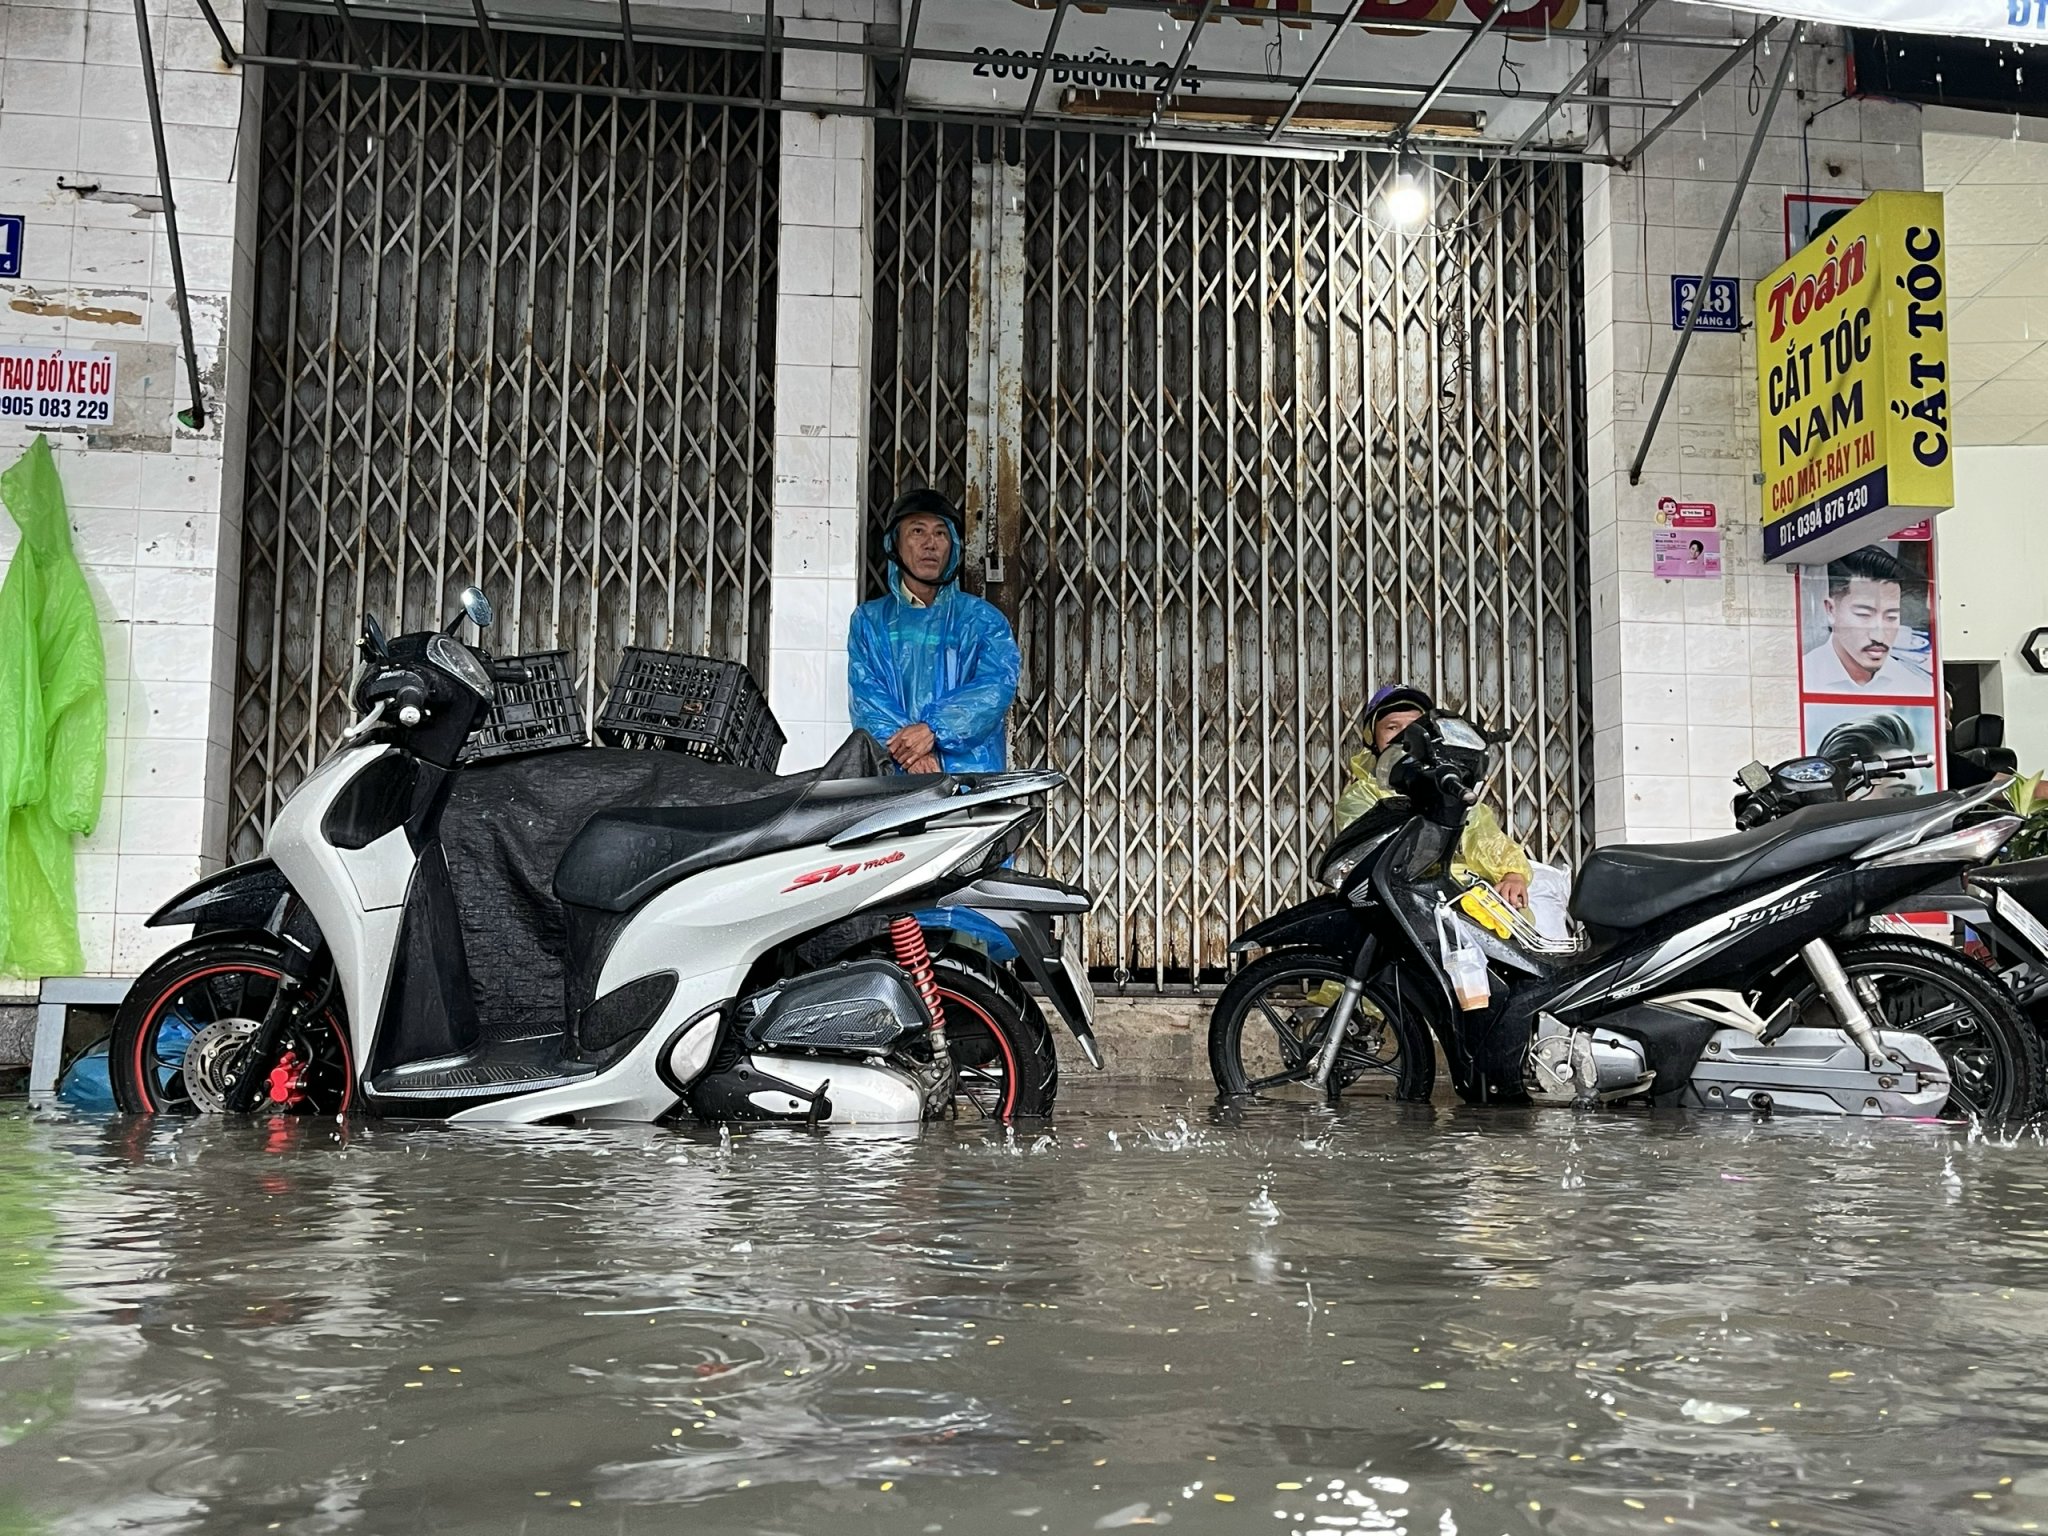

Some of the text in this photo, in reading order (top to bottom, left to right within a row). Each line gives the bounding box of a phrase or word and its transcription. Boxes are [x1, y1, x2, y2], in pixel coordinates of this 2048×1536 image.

[1695, 313, 1723, 326] HÁNG
[1891, 226, 1948, 467] CẮT TÓC
[37, 349, 64, 392] ĐỔI
[66, 360, 88, 394] XE
[90, 356, 111, 395] CŨ
[1769, 307, 1871, 417] CẮT TÓC
[0, 395, 109, 420] 905 083 229
[1779, 379, 1864, 467] NAM
[1772, 475, 1794, 514] CẠO
[1854, 430, 1875, 468] TAI
[1797, 507, 1822, 537] 0394
[1825, 496, 1845, 525] 876
[1847, 484, 1868, 514] 230
